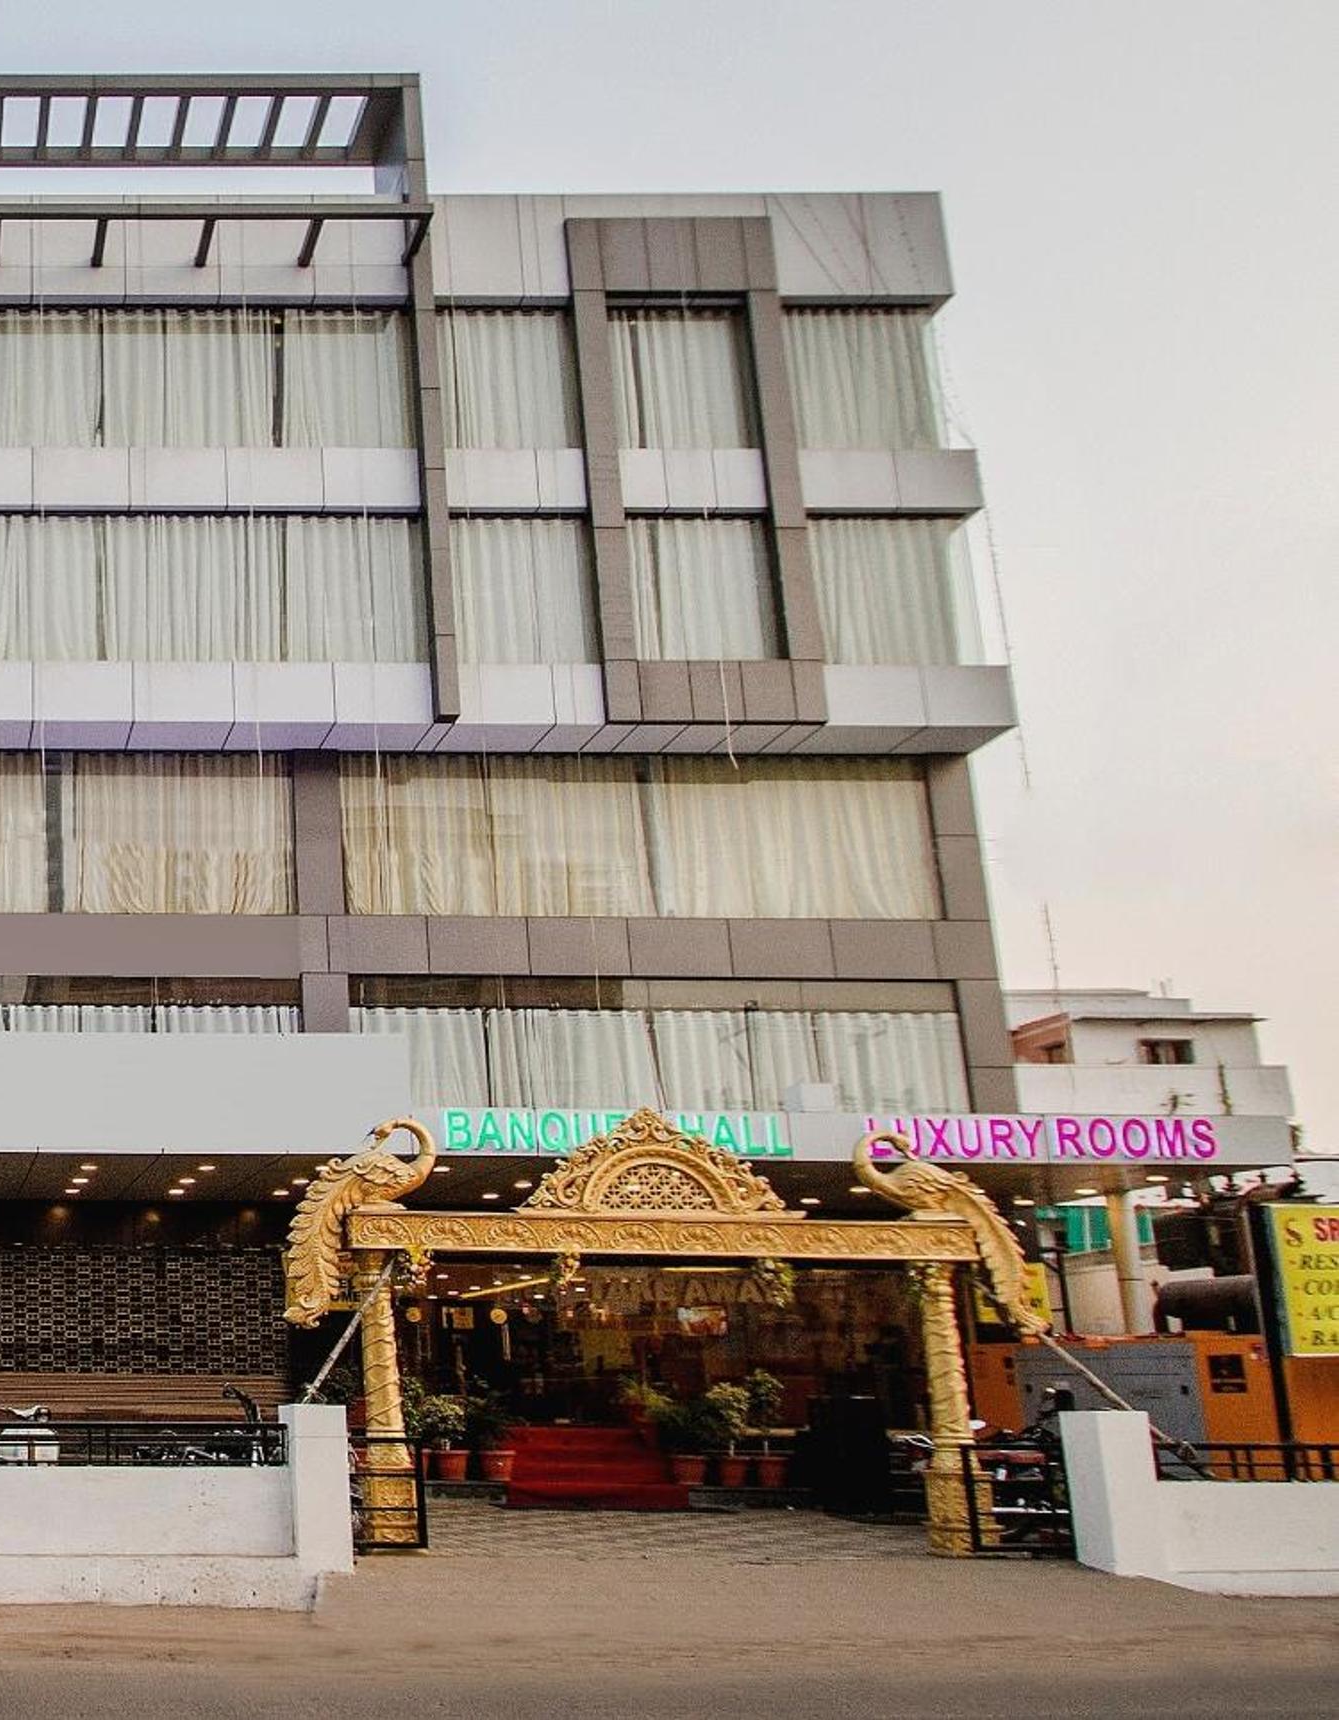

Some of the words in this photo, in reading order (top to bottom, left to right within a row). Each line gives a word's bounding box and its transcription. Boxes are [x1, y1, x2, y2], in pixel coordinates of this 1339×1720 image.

[444, 1109, 627, 1152] BANQU
[867, 1117, 1044, 1159] LUXURY
[1055, 1117, 1216, 1159] ROOMS
